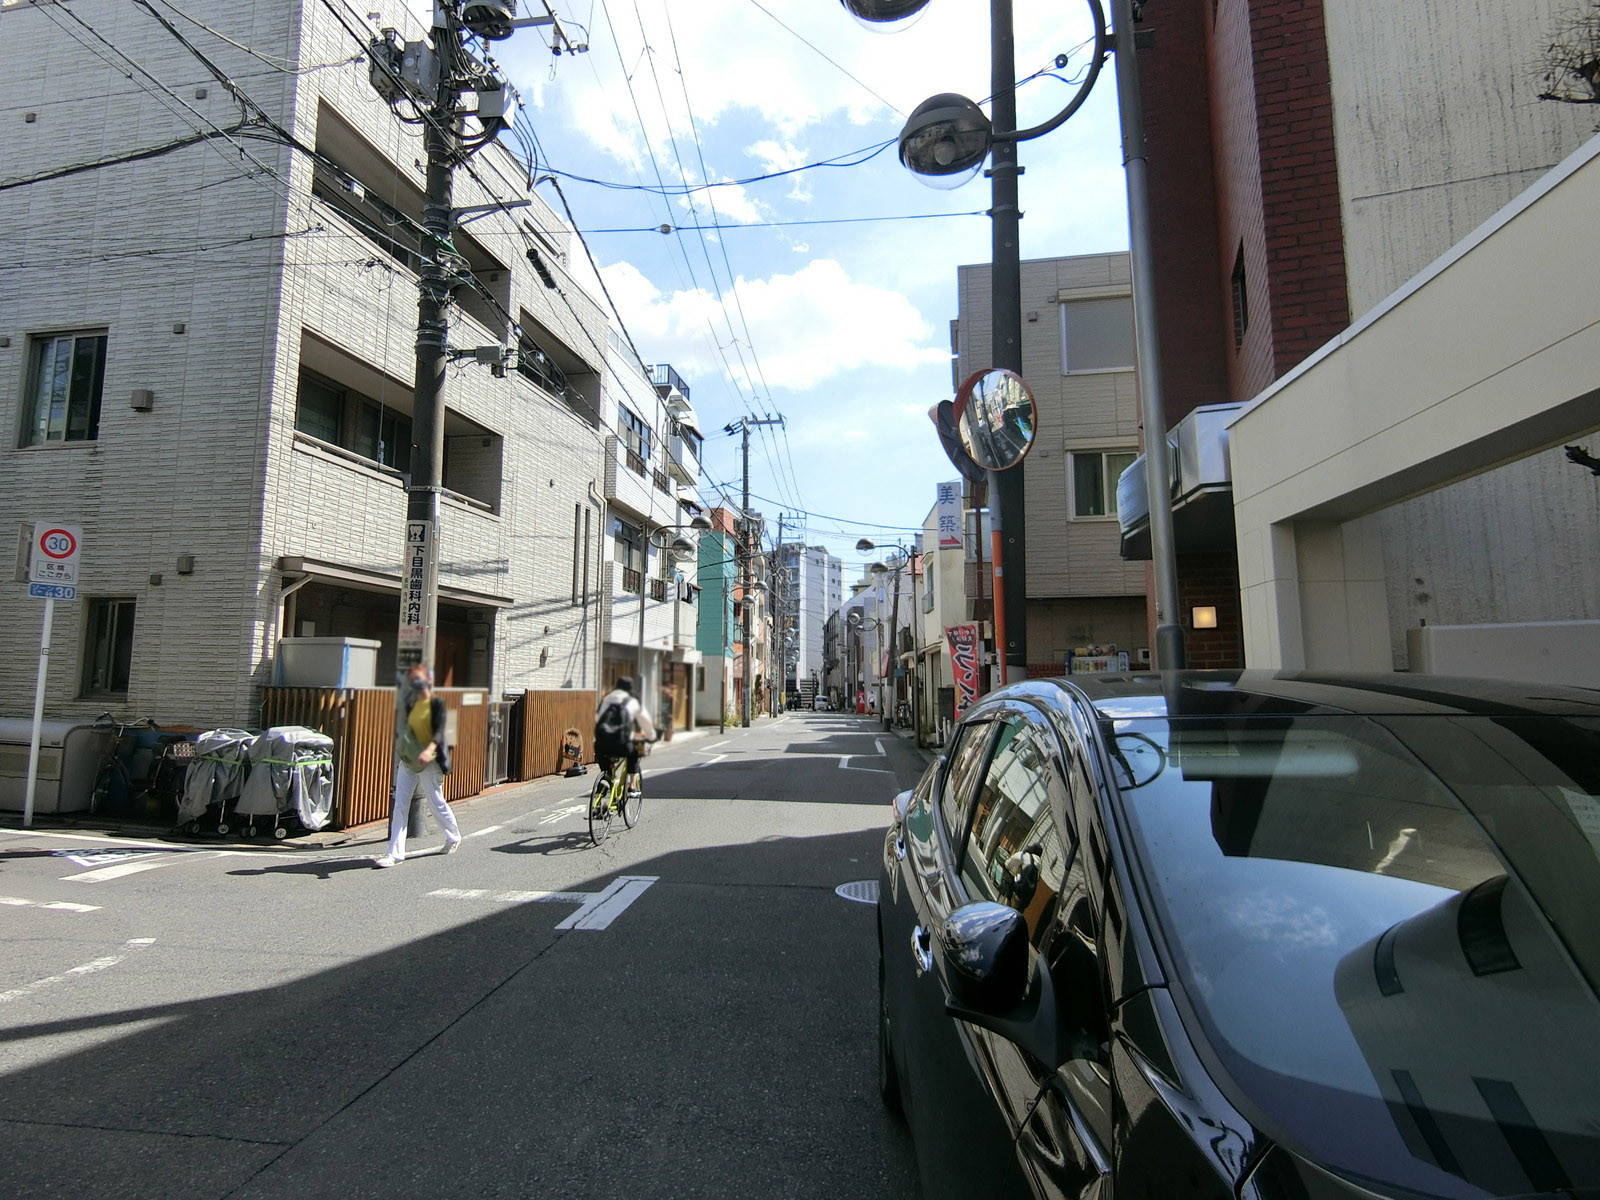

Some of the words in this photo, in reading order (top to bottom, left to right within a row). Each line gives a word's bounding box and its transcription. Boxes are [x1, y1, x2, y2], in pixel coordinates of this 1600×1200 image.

[939, 485, 956, 532] 美築
[48, 537, 69, 551] 30
[38, 570, 72, 579] ここから
[407, 545, 425, 625] 下目黒歯科内科
